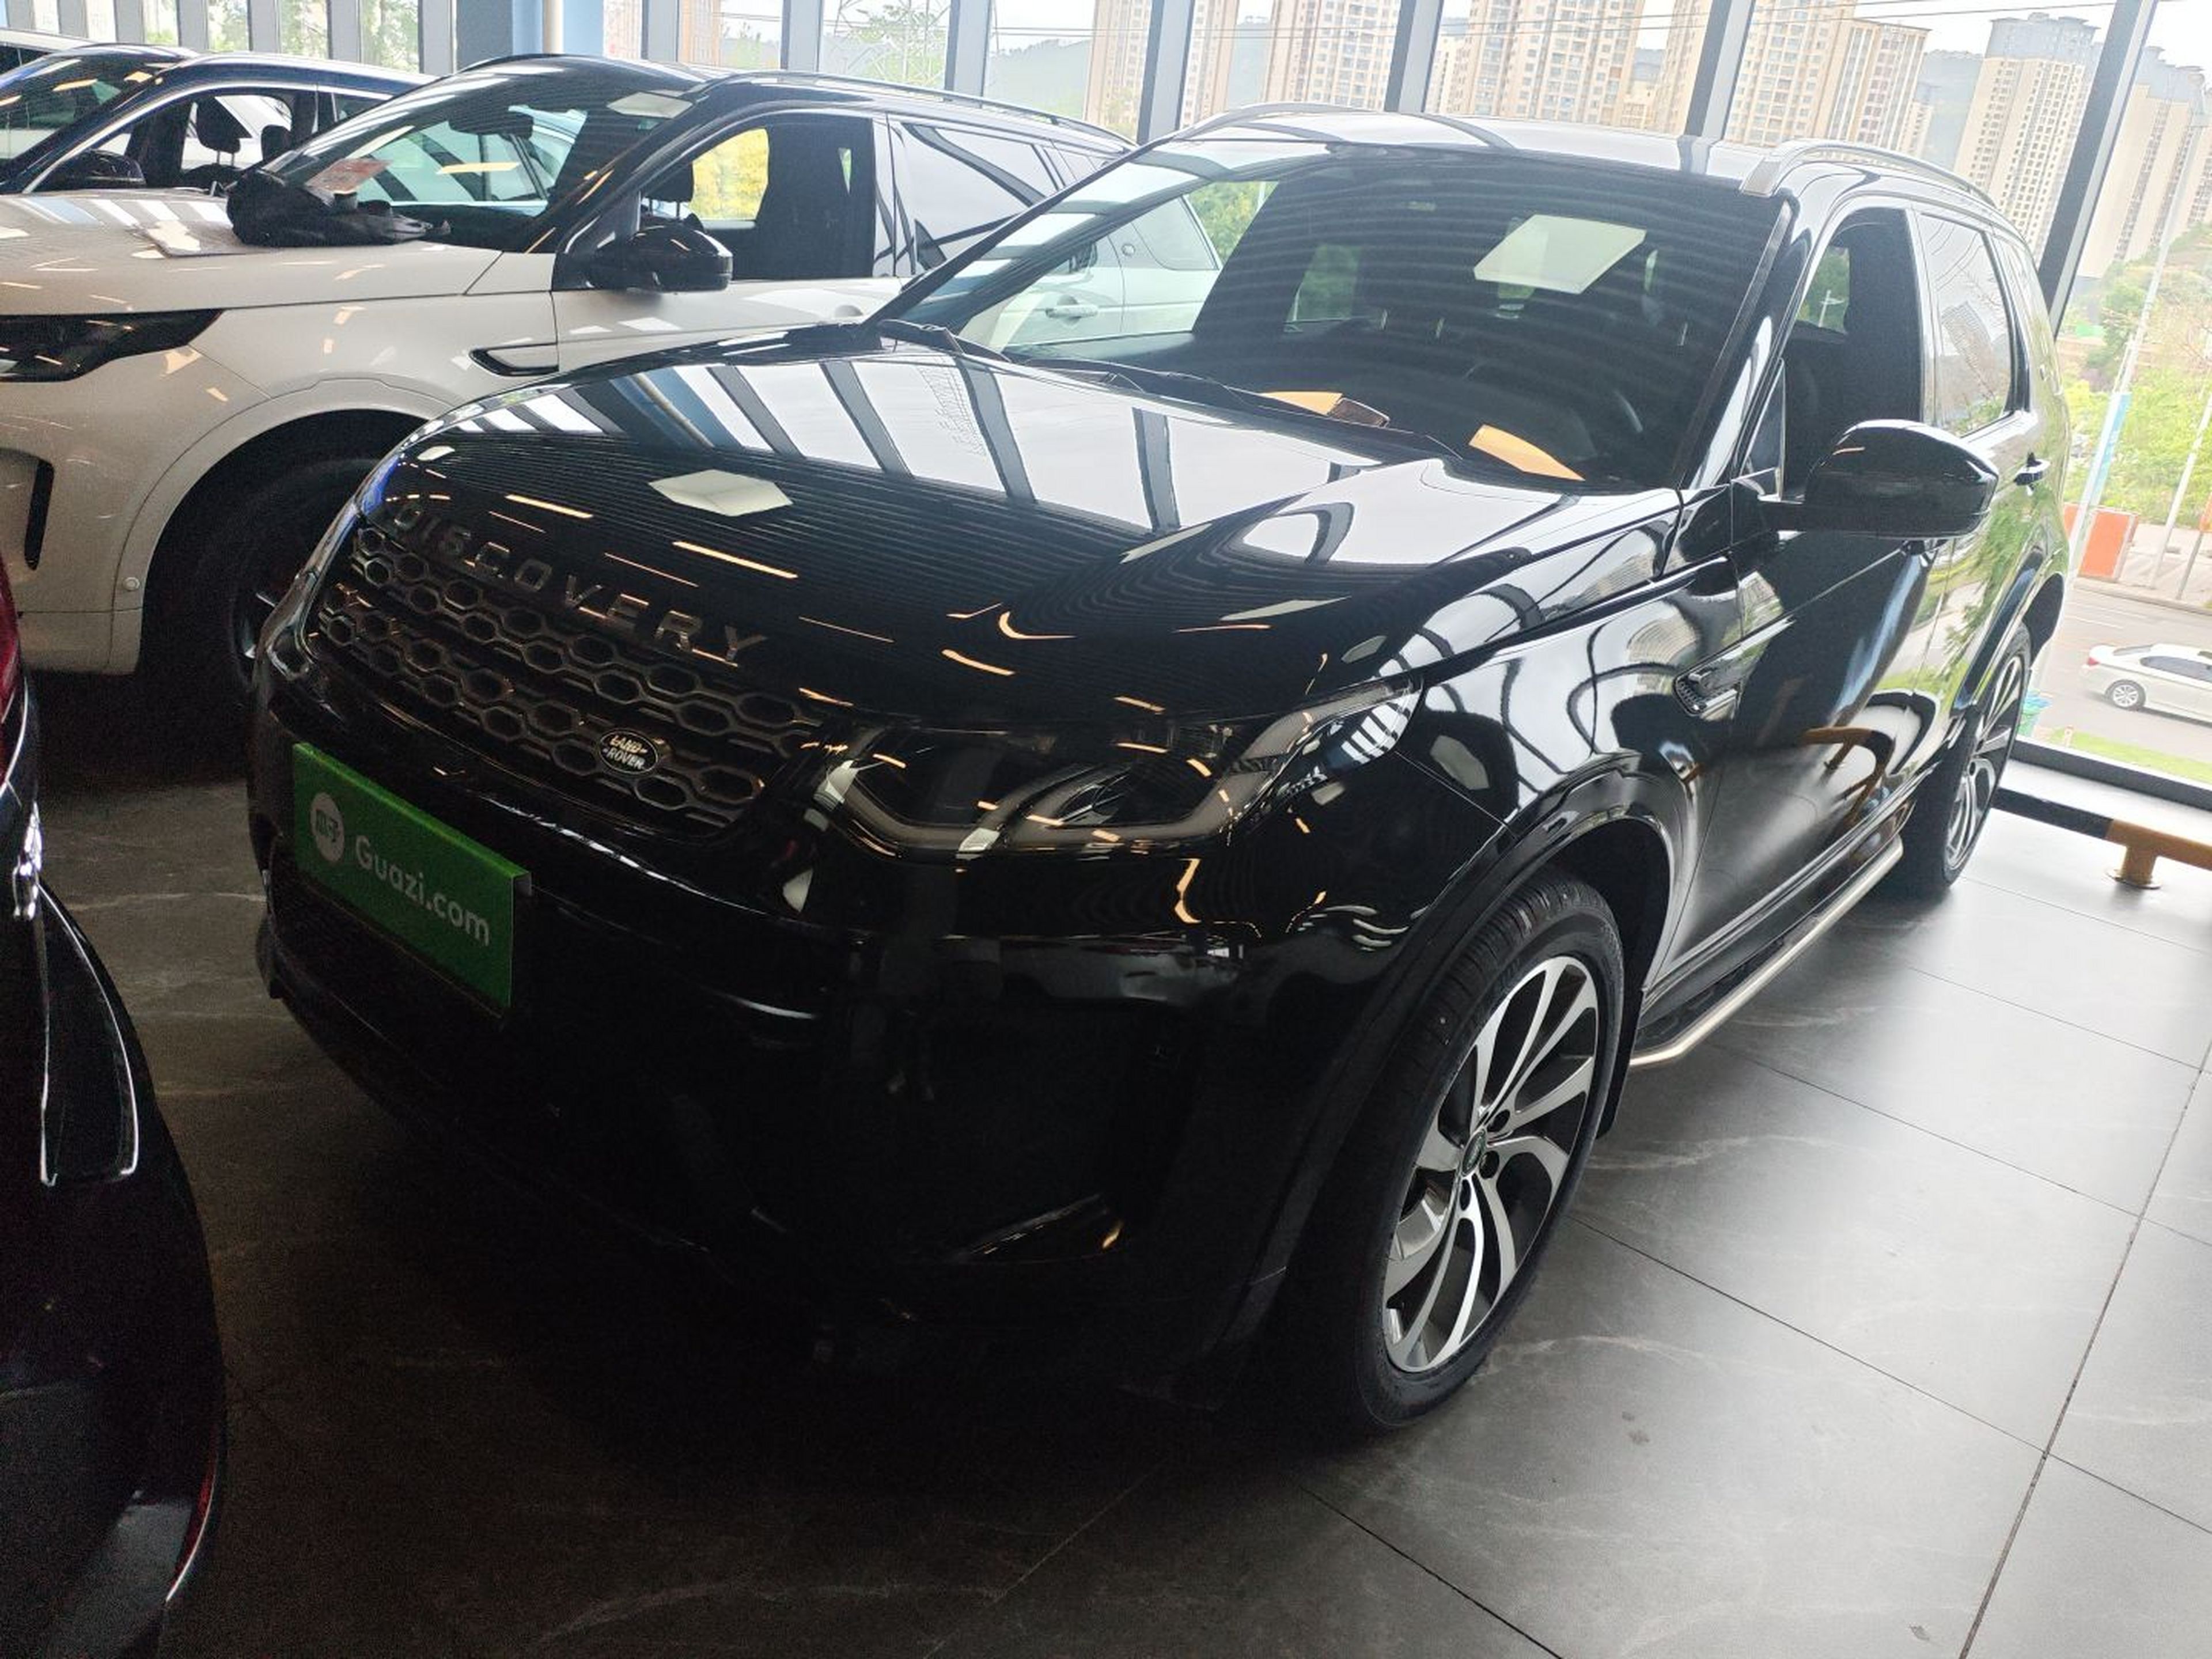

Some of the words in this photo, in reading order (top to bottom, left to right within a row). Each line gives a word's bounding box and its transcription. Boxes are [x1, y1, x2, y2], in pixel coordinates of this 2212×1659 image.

[392, 502, 767, 661] DISCOVERY
[606, 747, 646, 770] ROVER
[609, 734, 643, 754] LAND
[355, 835, 490, 946] Guazi.com
